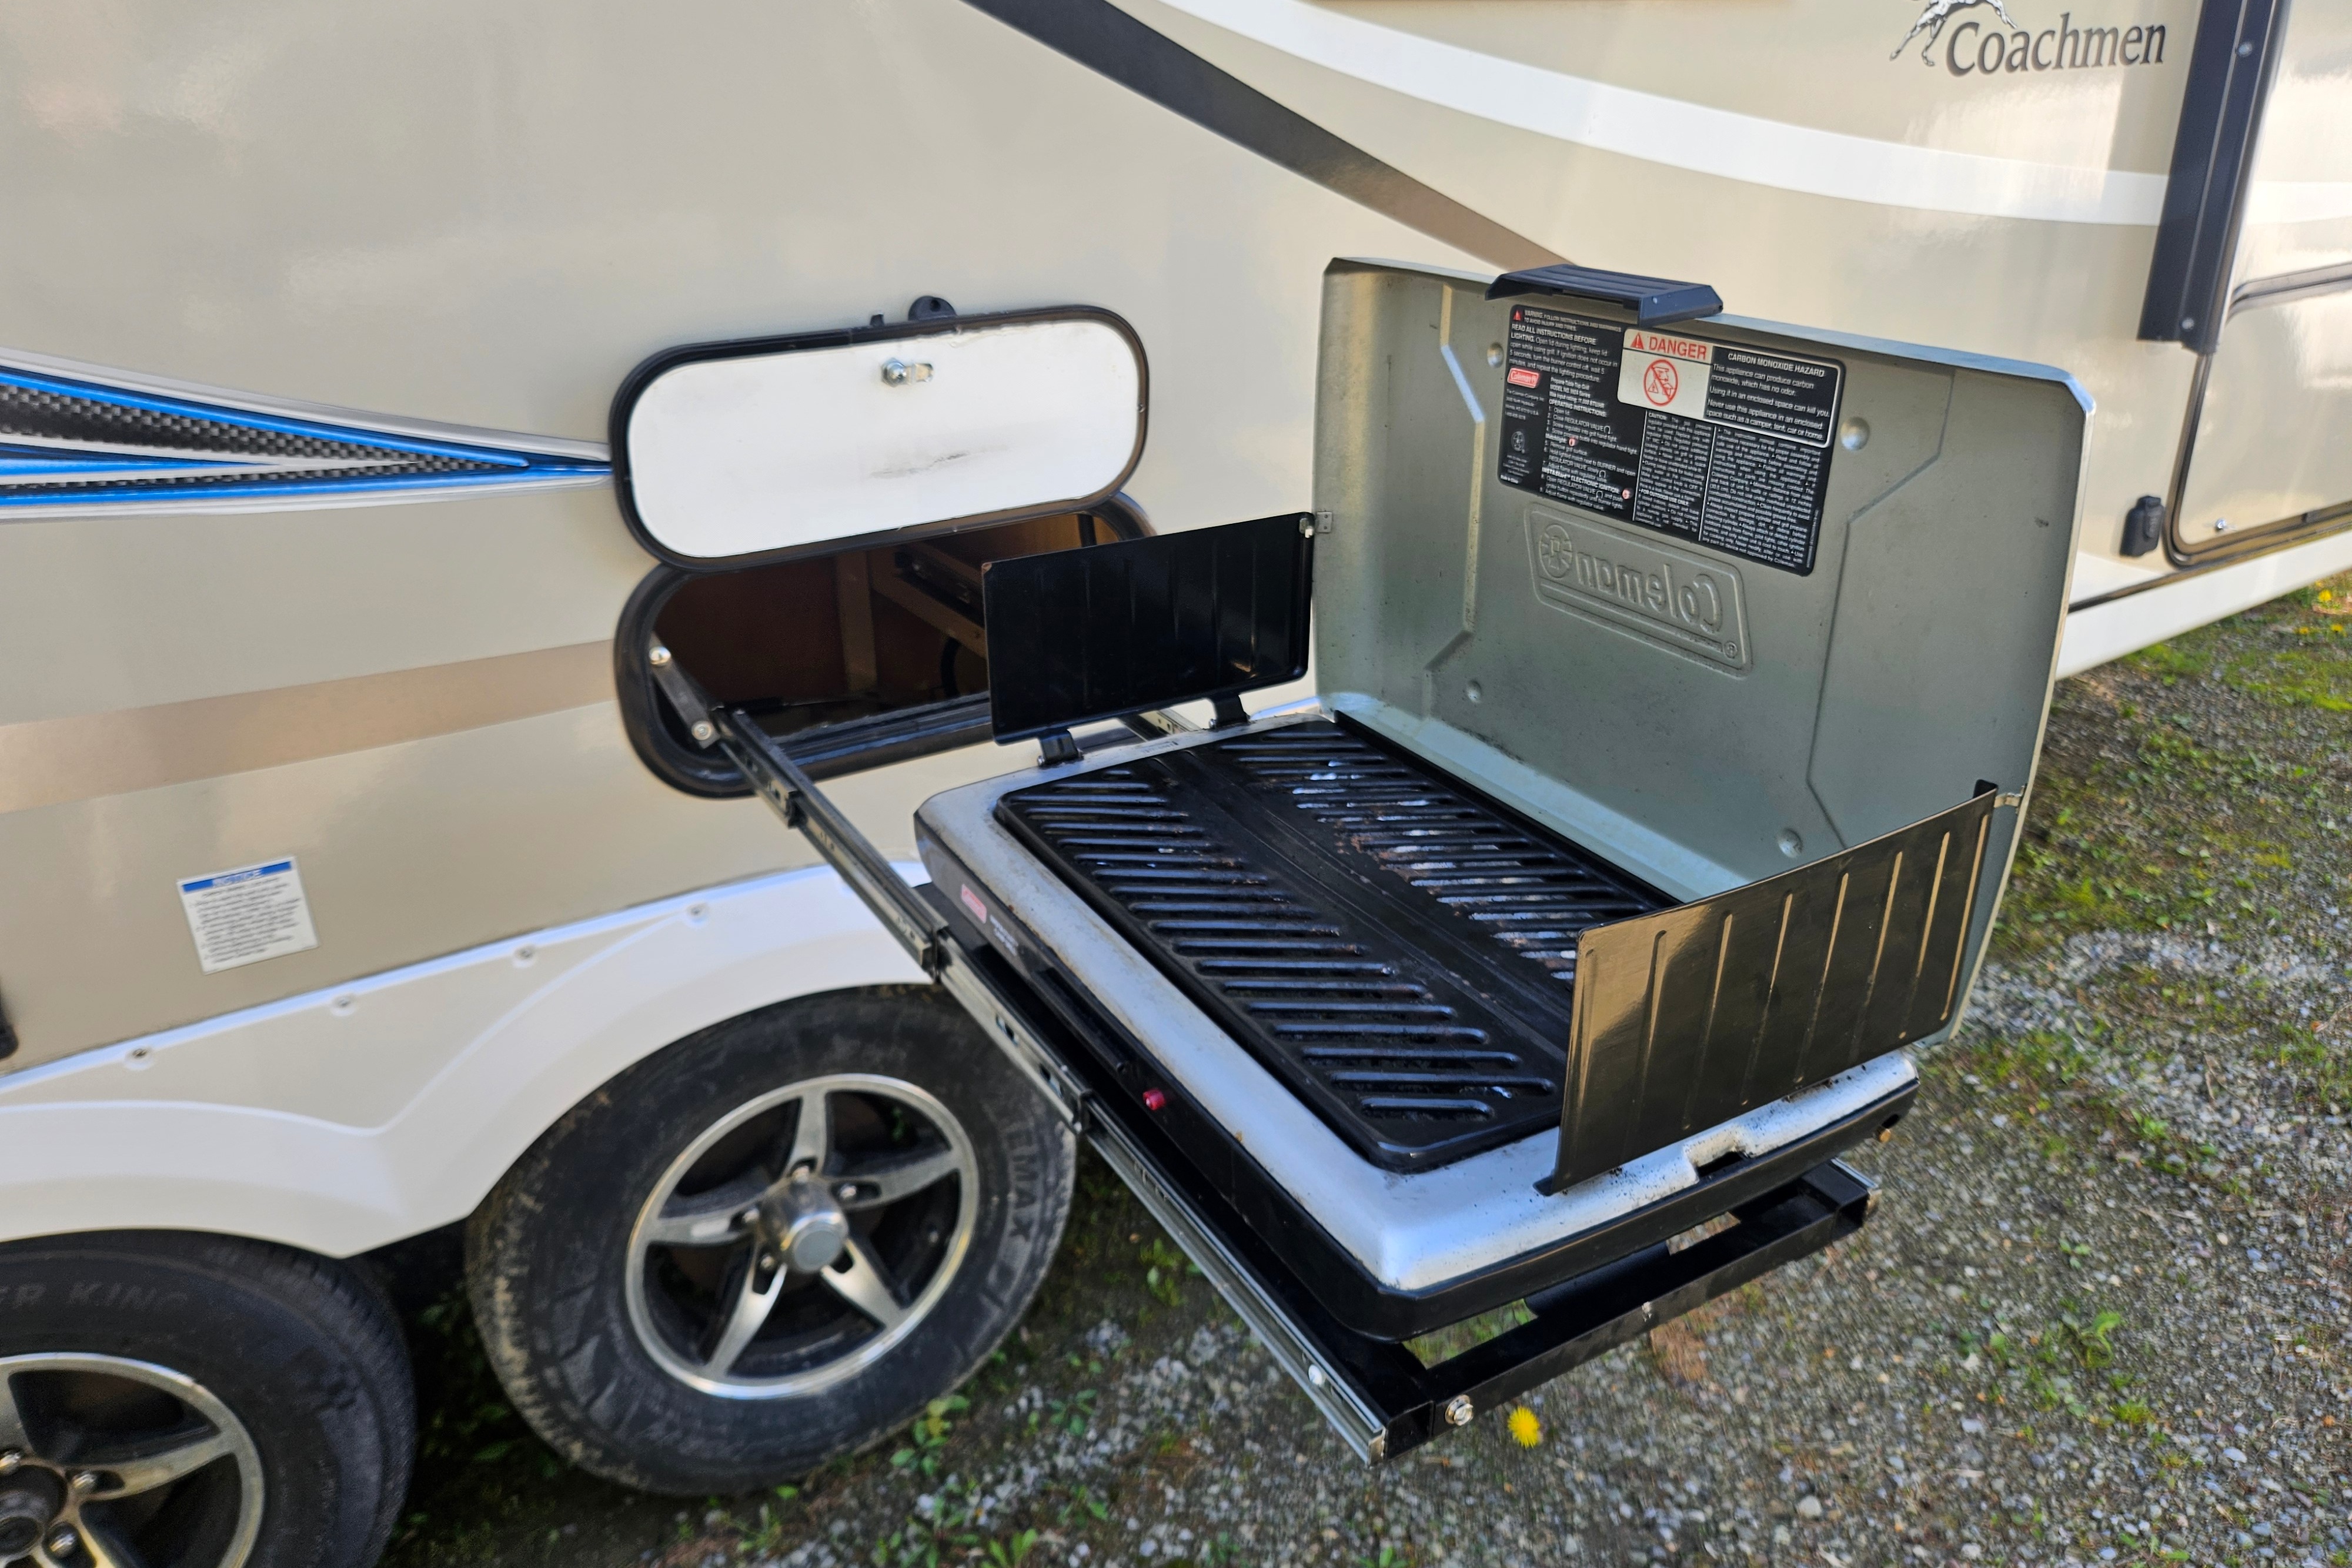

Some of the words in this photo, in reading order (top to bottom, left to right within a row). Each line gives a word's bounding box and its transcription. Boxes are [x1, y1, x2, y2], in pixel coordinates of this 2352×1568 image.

[1946, 12, 2167, 77] Coachmen
[1536, 328, 1573, 340] INSTRUCTIONS
[1573, 335, 1596, 345] BEFORE
[1648, 337, 1708, 360] DANGER
[1728, 353, 1756, 364] CARBON
[1757, 358, 1793, 371] MONOXIDE
[1795, 365, 1825, 377] HAZARD
[1713, 363, 1725, 372] This
[1725, 367, 1753, 377] appliance
[1766, 375, 1791, 385] produce
[1792, 380, 1814, 389] carbon
[1742, 380, 1758, 388] which
[1759, 382, 1770, 390] has
[1549, 399, 1573, 409] OPERATING
[1709, 386, 1726, 396] Using
[1746, 394, 1773, 405] enclosed
[1775, 400, 1793, 409] space
[1708, 398, 1724, 407] Never
[1737, 405, 1748, 413] this
[1748, 409, 1777, 419] appliance
[1564, 417, 1589, 427] REGULATOR
[1590, 423, 1604, 431] VALVE
[1571, 475, 1598, 487] ELECTRONIC
